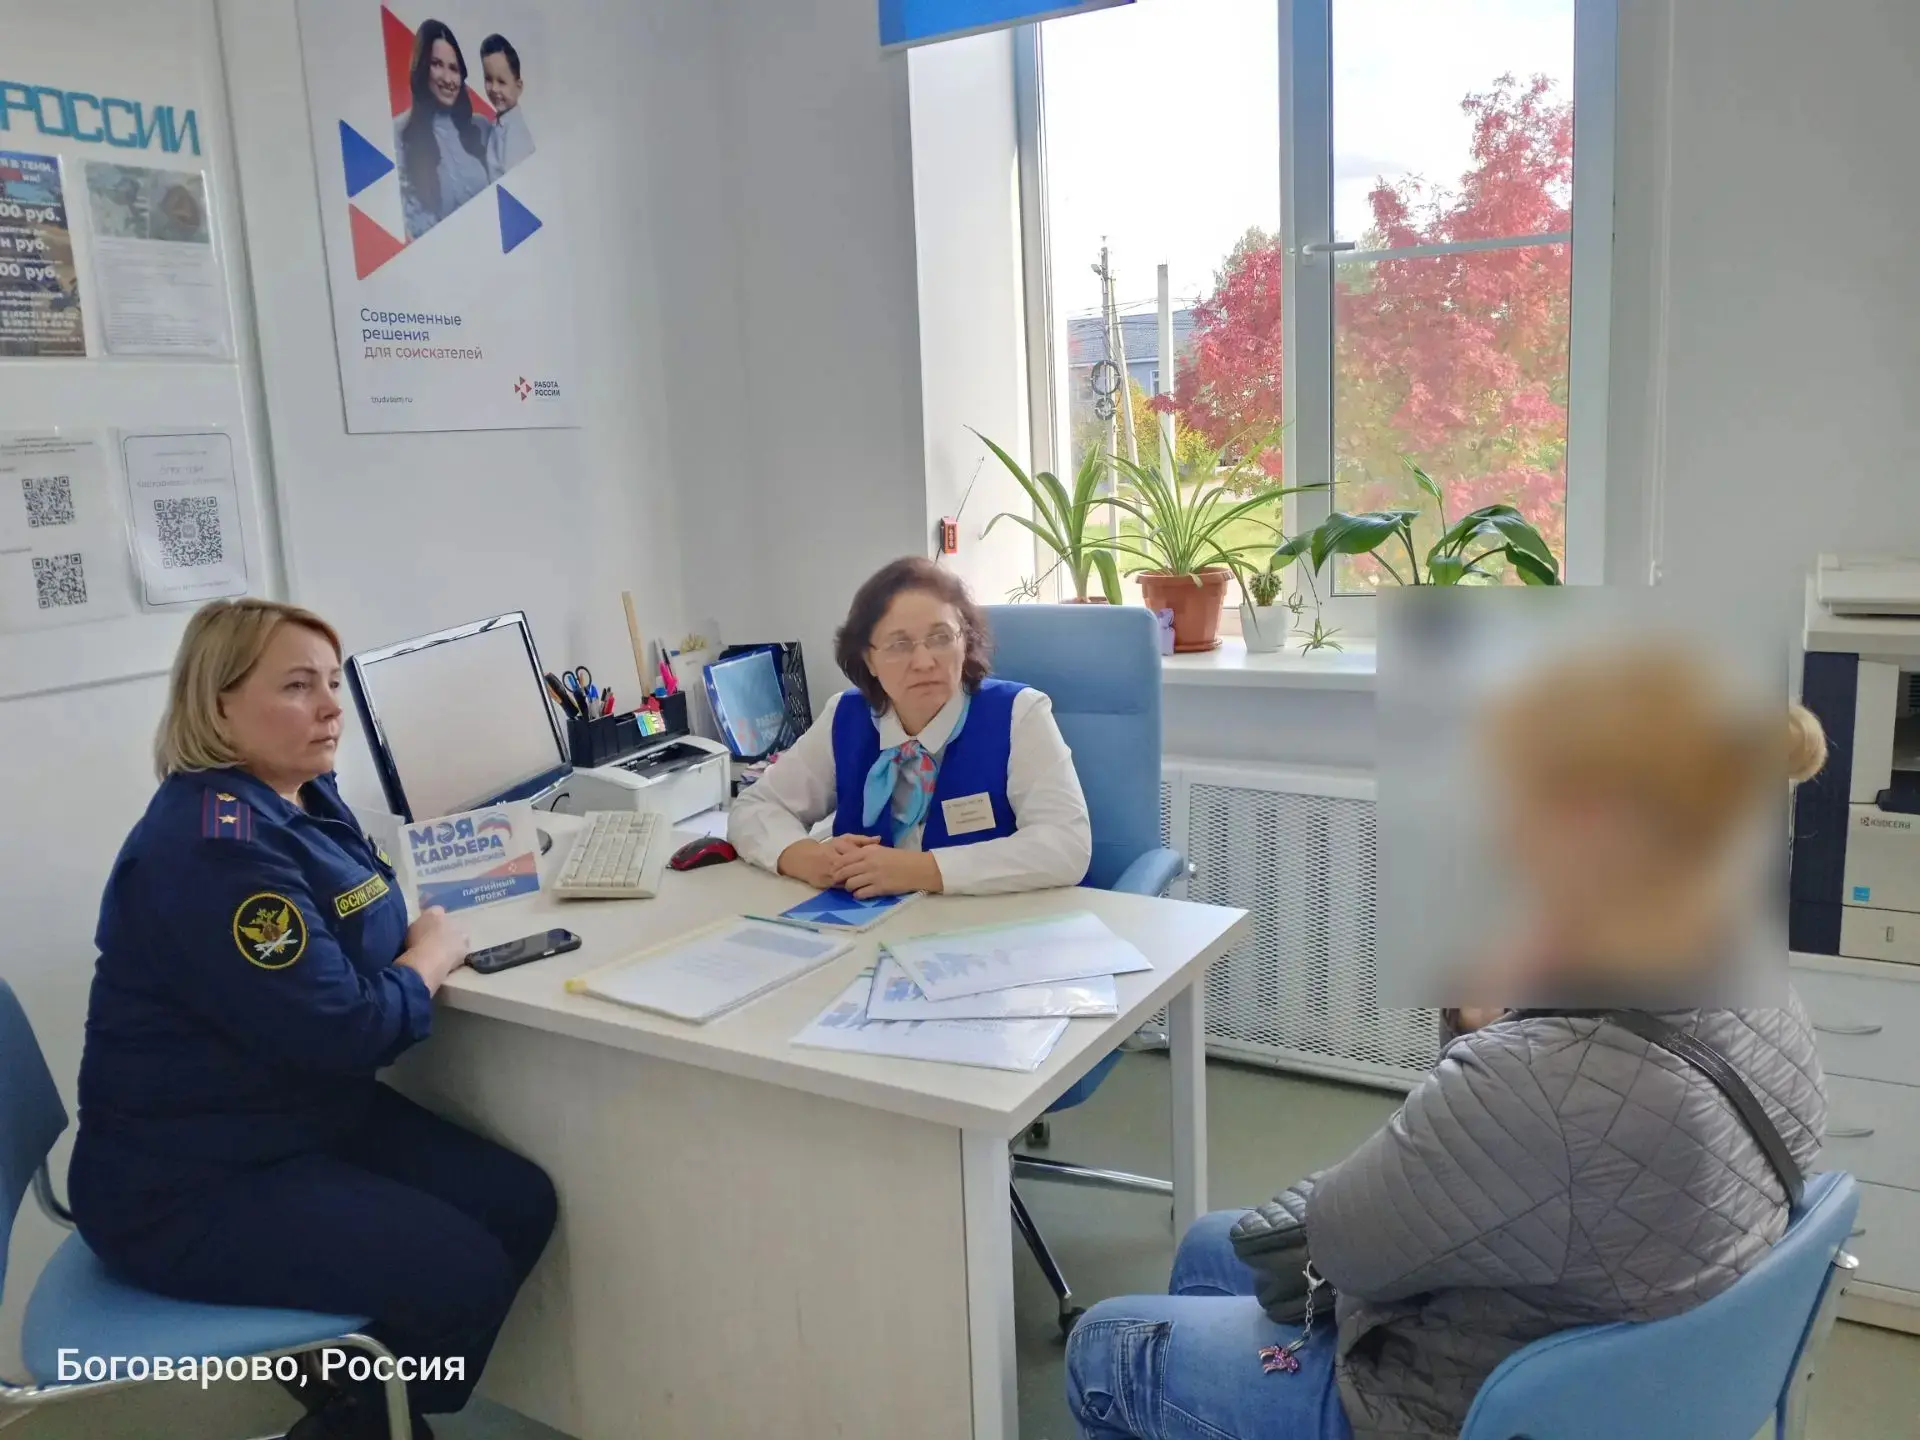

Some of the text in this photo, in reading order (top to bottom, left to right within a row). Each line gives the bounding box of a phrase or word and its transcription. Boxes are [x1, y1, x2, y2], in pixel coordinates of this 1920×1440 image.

[0, 80, 200, 156] РОССИИ
[25, 207, 61, 224] руб.
[15, 238, 50, 253] руб.
[24, 266, 61, 281] руб.
[360, 308, 462, 326] Современные
[362, 328, 430, 342] решения
[364, 345, 483, 360] для соискателей
[534, 381, 559, 389] РАБОТА
[535, 389, 561, 397] РОССИИ
[413, 834, 504, 867] КАРЬЕРА
[462, 878, 516, 896] ПАРТИЙНЫЙ
[340, 889, 367, 911] ФСИН
[474, 888, 508, 903] ПРОЕКТ
